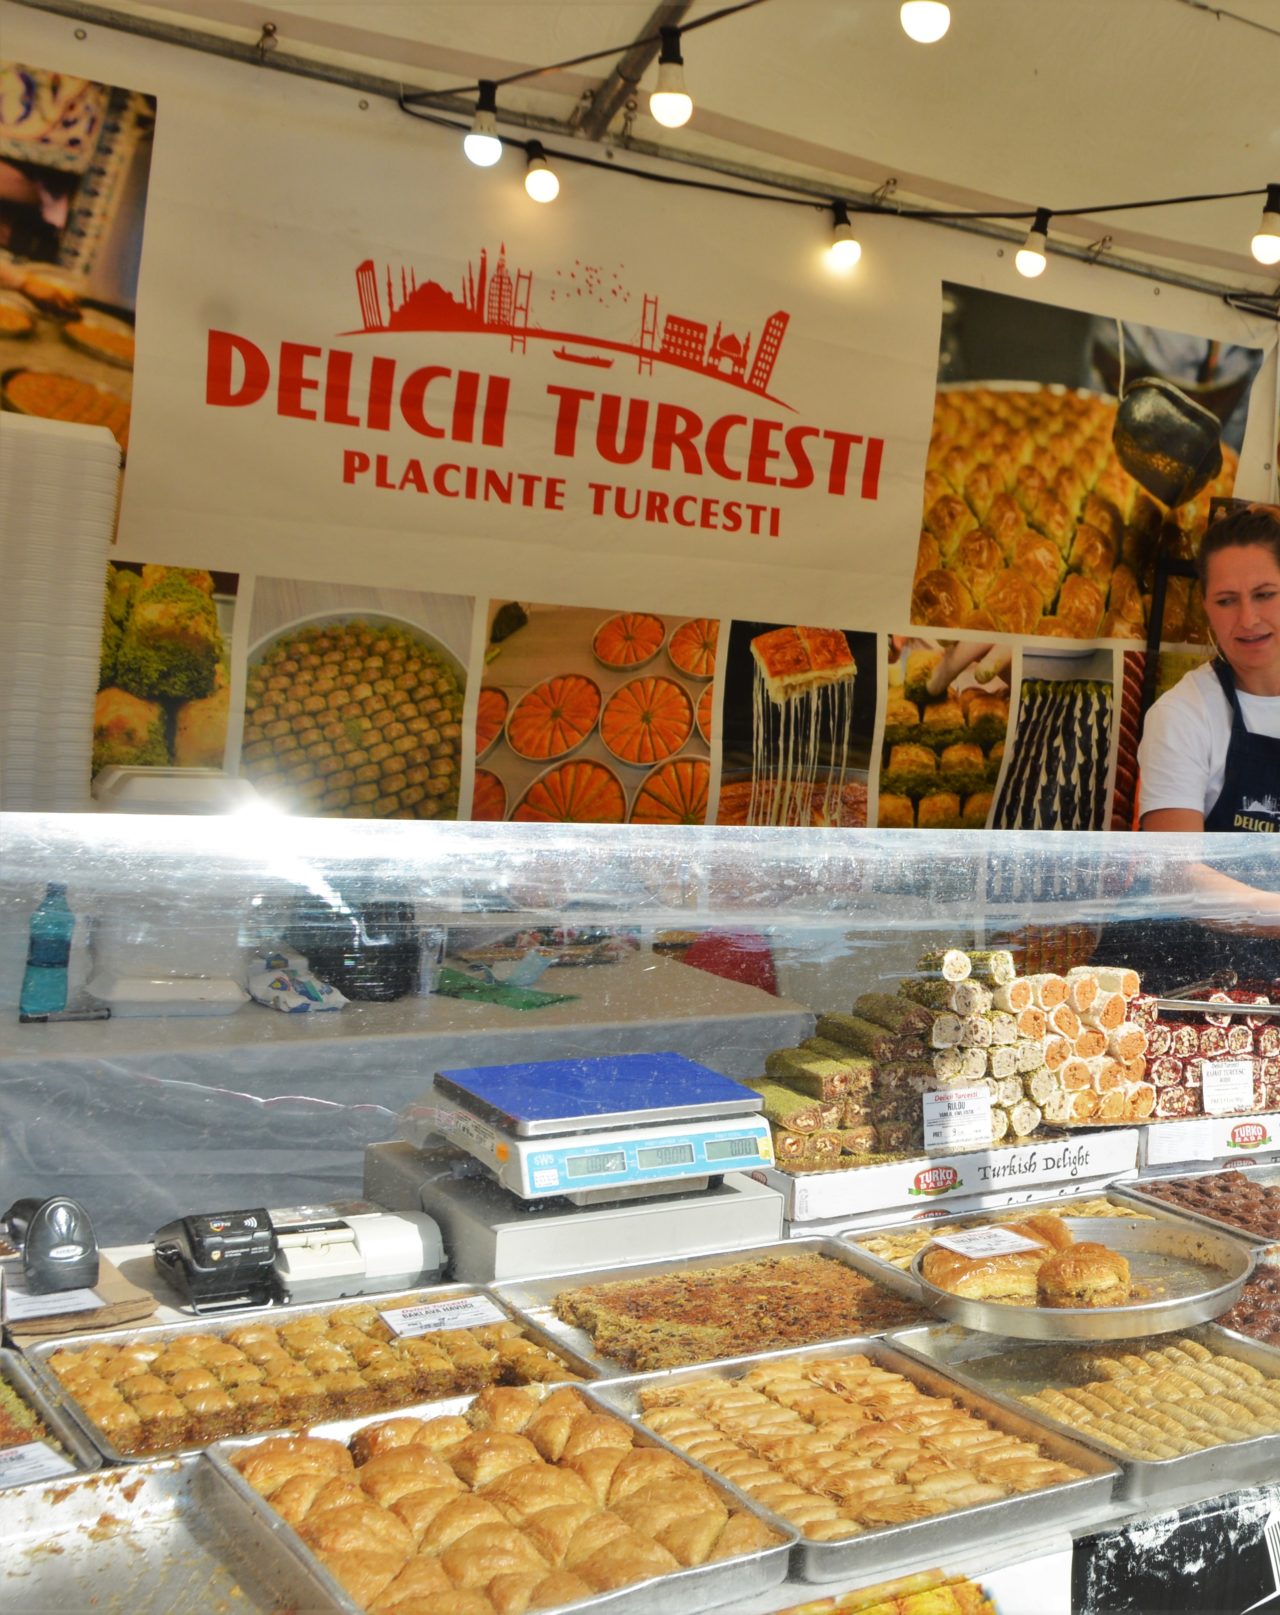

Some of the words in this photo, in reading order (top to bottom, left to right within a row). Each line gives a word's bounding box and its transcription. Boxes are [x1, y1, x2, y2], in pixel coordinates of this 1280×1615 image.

[205, 329, 511, 448] DELICII
[546, 384, 885, 501] TURCESTI
[341, 449, 566, 511] PLACINTE
[587, 482, 782, 538] TURCESTI
[1233, 814, 1275, 832] DELICII
[1233, 1124, 1263, 1138] TURKO
[977, 1151, 1037, 1181] Turkish
[1042, 1145, 1091, 1177] Delight
[918, 1168, 954, 1185] TURKO
[919, 1179, 953, 1190] BABA
